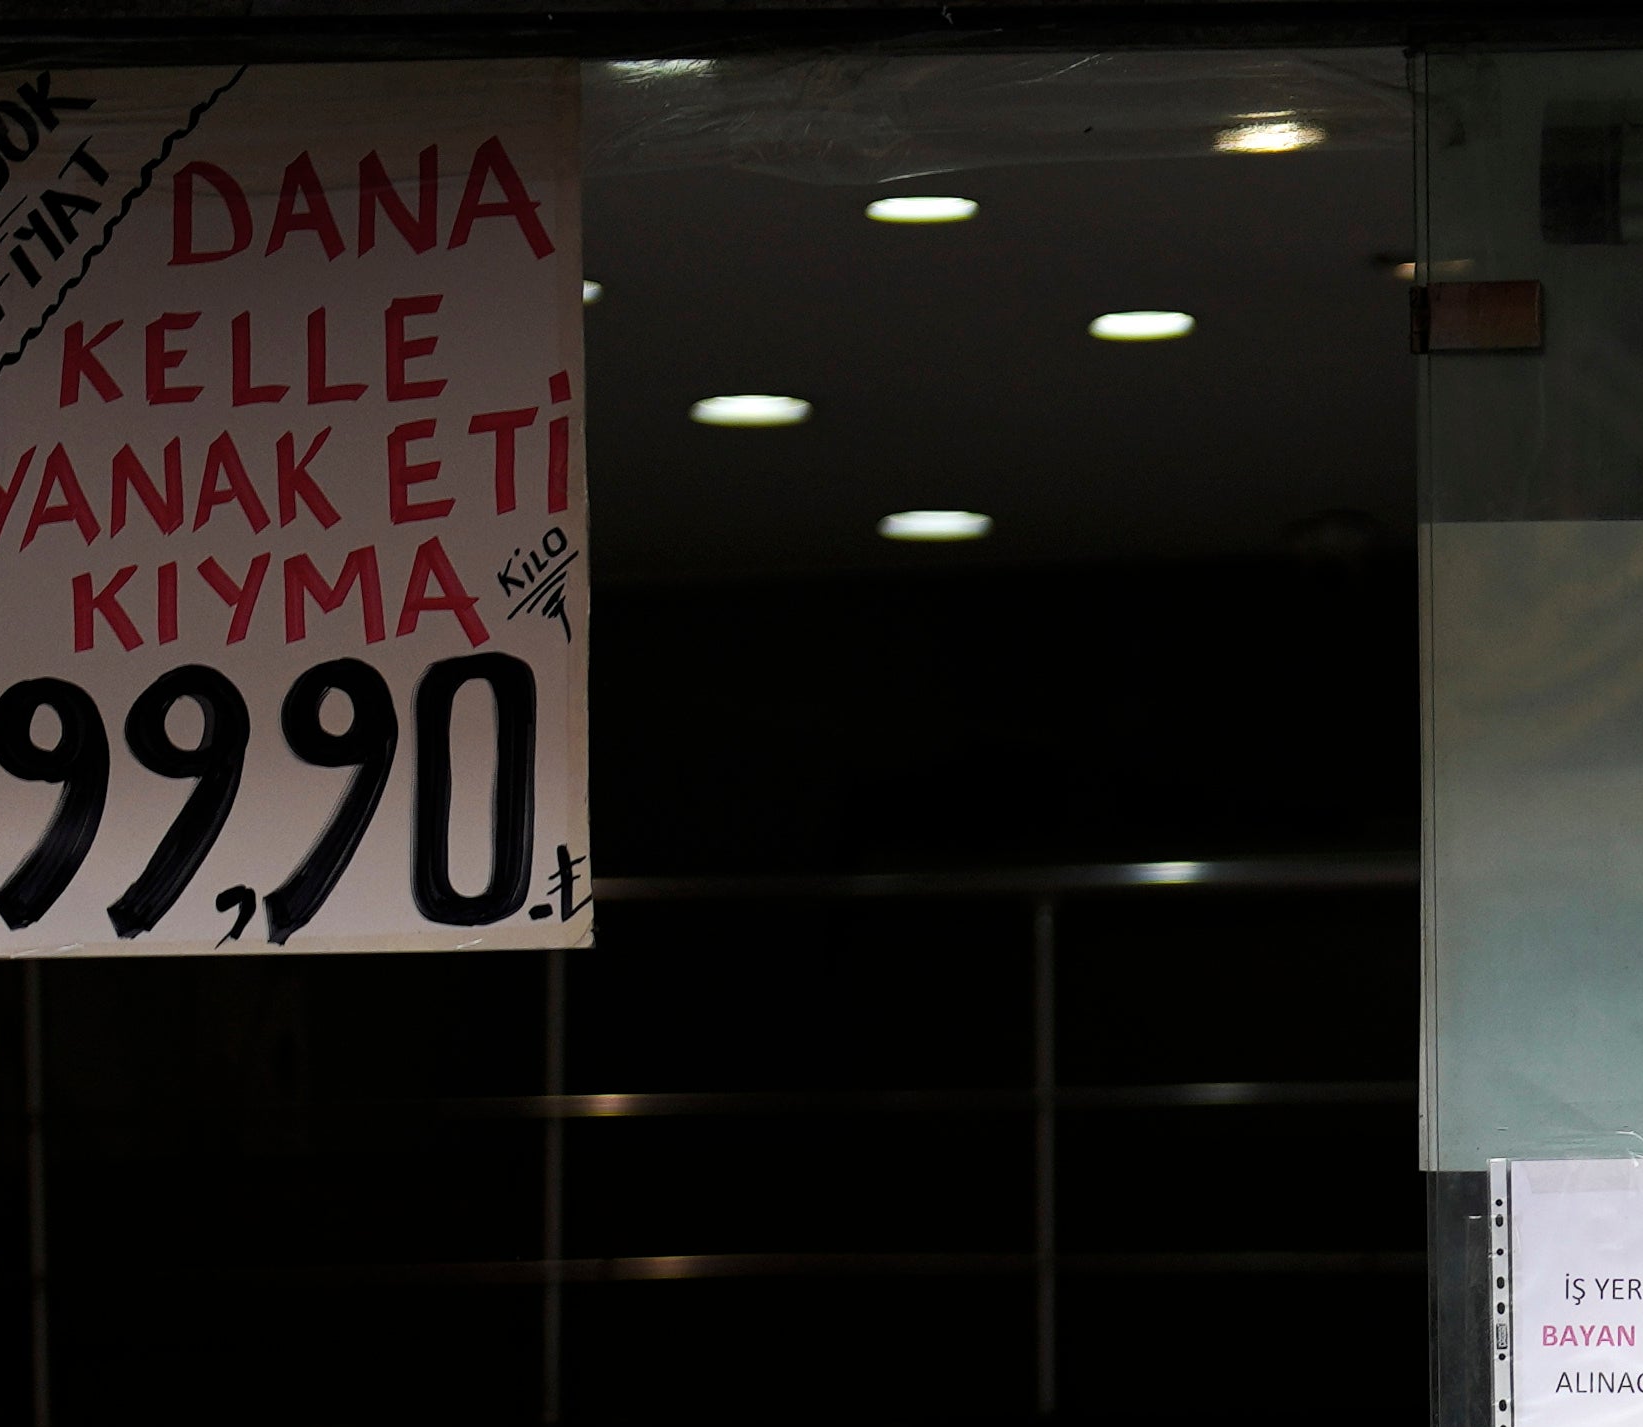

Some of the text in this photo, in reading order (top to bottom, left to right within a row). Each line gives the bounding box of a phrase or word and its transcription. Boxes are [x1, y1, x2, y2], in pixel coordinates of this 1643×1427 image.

[168, 135, 555, 266] DANA
[59, 293, 447, 408] KELLE
[387, 370, 571, 524] ETİ
[73, 535, 492, 653] KIYMA
[497, 527, 569, 599] KİLO
[1542, 1325, 1636, 1348] BAYAN
[1564, 1273, 1586, 1305] İŞ
